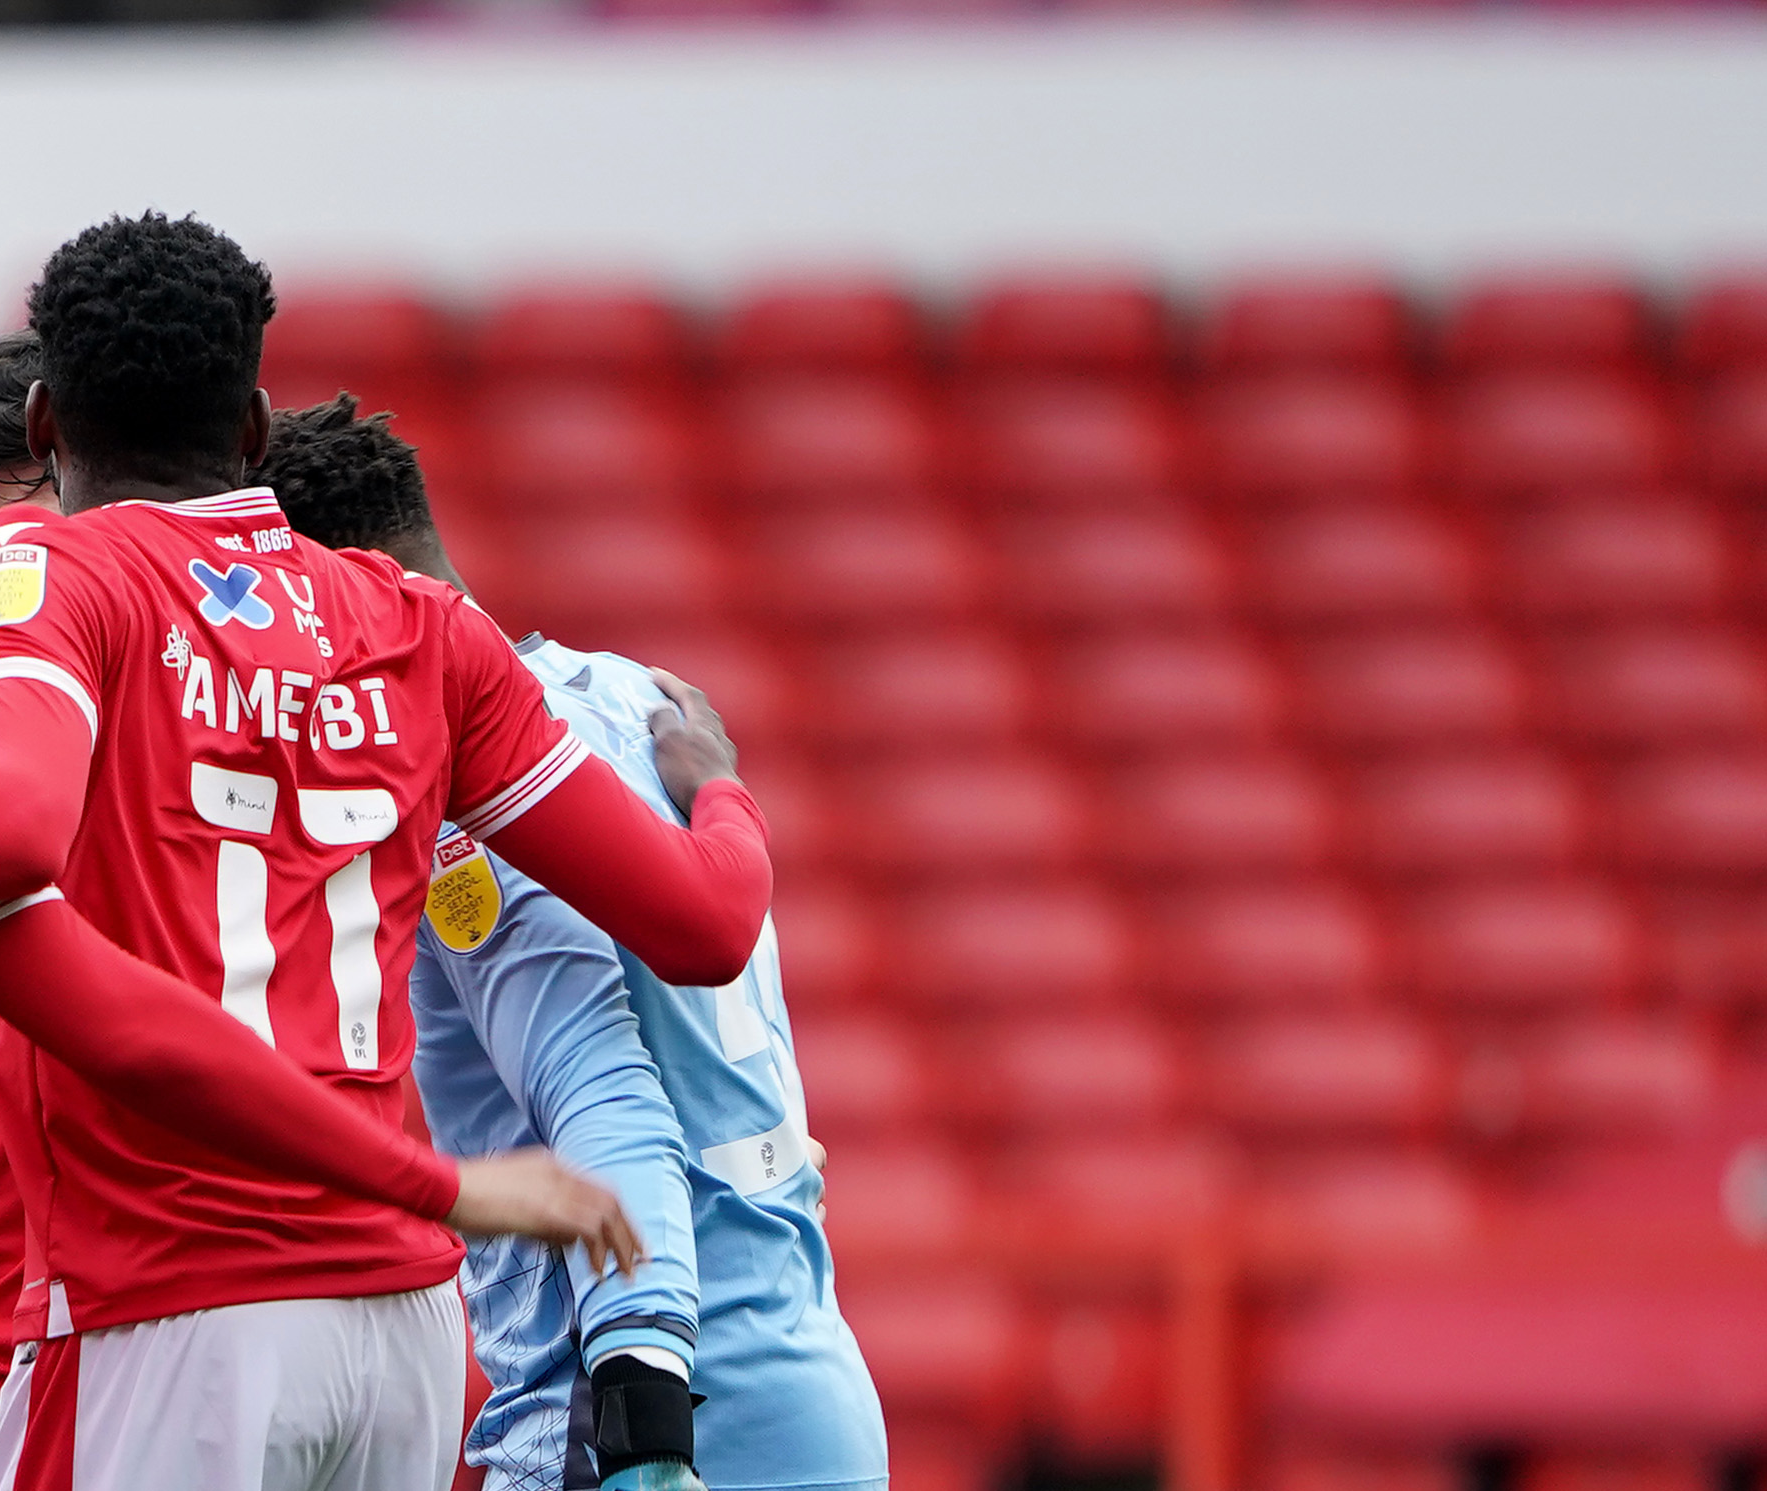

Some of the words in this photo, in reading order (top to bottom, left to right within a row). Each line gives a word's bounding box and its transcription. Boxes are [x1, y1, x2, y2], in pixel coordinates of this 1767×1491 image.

[251, 526, 293, 554] 1865
[181, 655, 398, 751] AMEBI
[439, 839, 472, 862] bet
